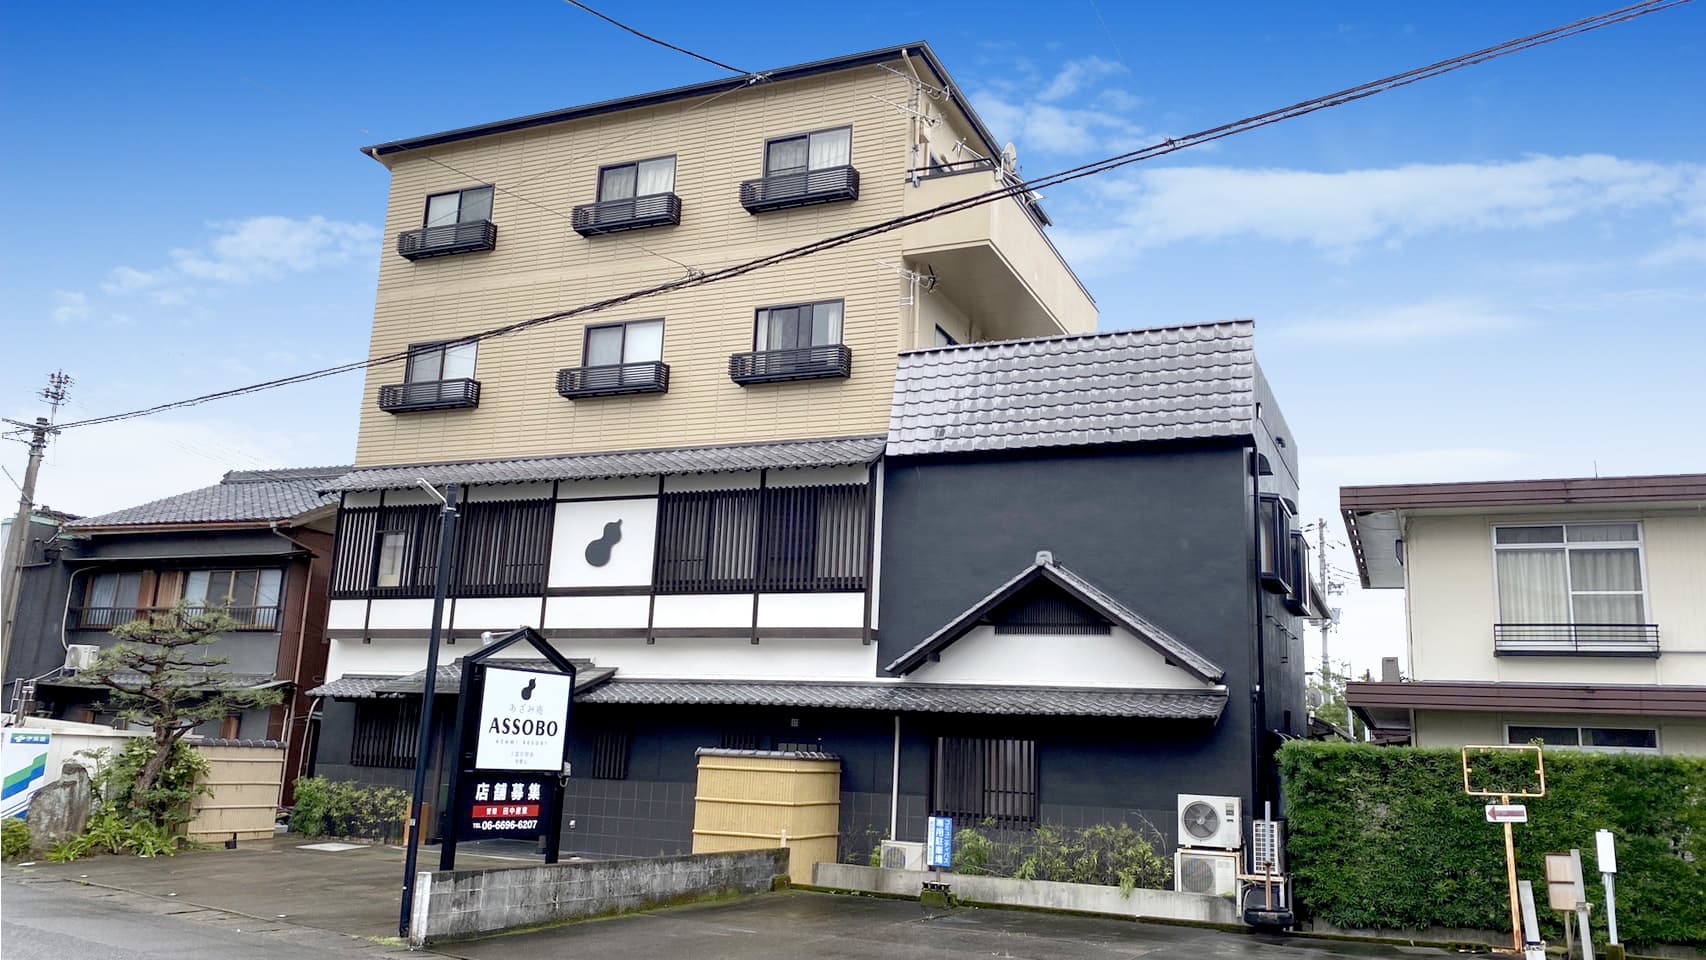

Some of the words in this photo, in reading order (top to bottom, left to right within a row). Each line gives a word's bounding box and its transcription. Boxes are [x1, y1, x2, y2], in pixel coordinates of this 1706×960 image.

[488, 717, 558, 737] ASSOBO
[475, 782, 541, 801] 店舗募集
[481, 820, 538, 831] 06-6696-6207
